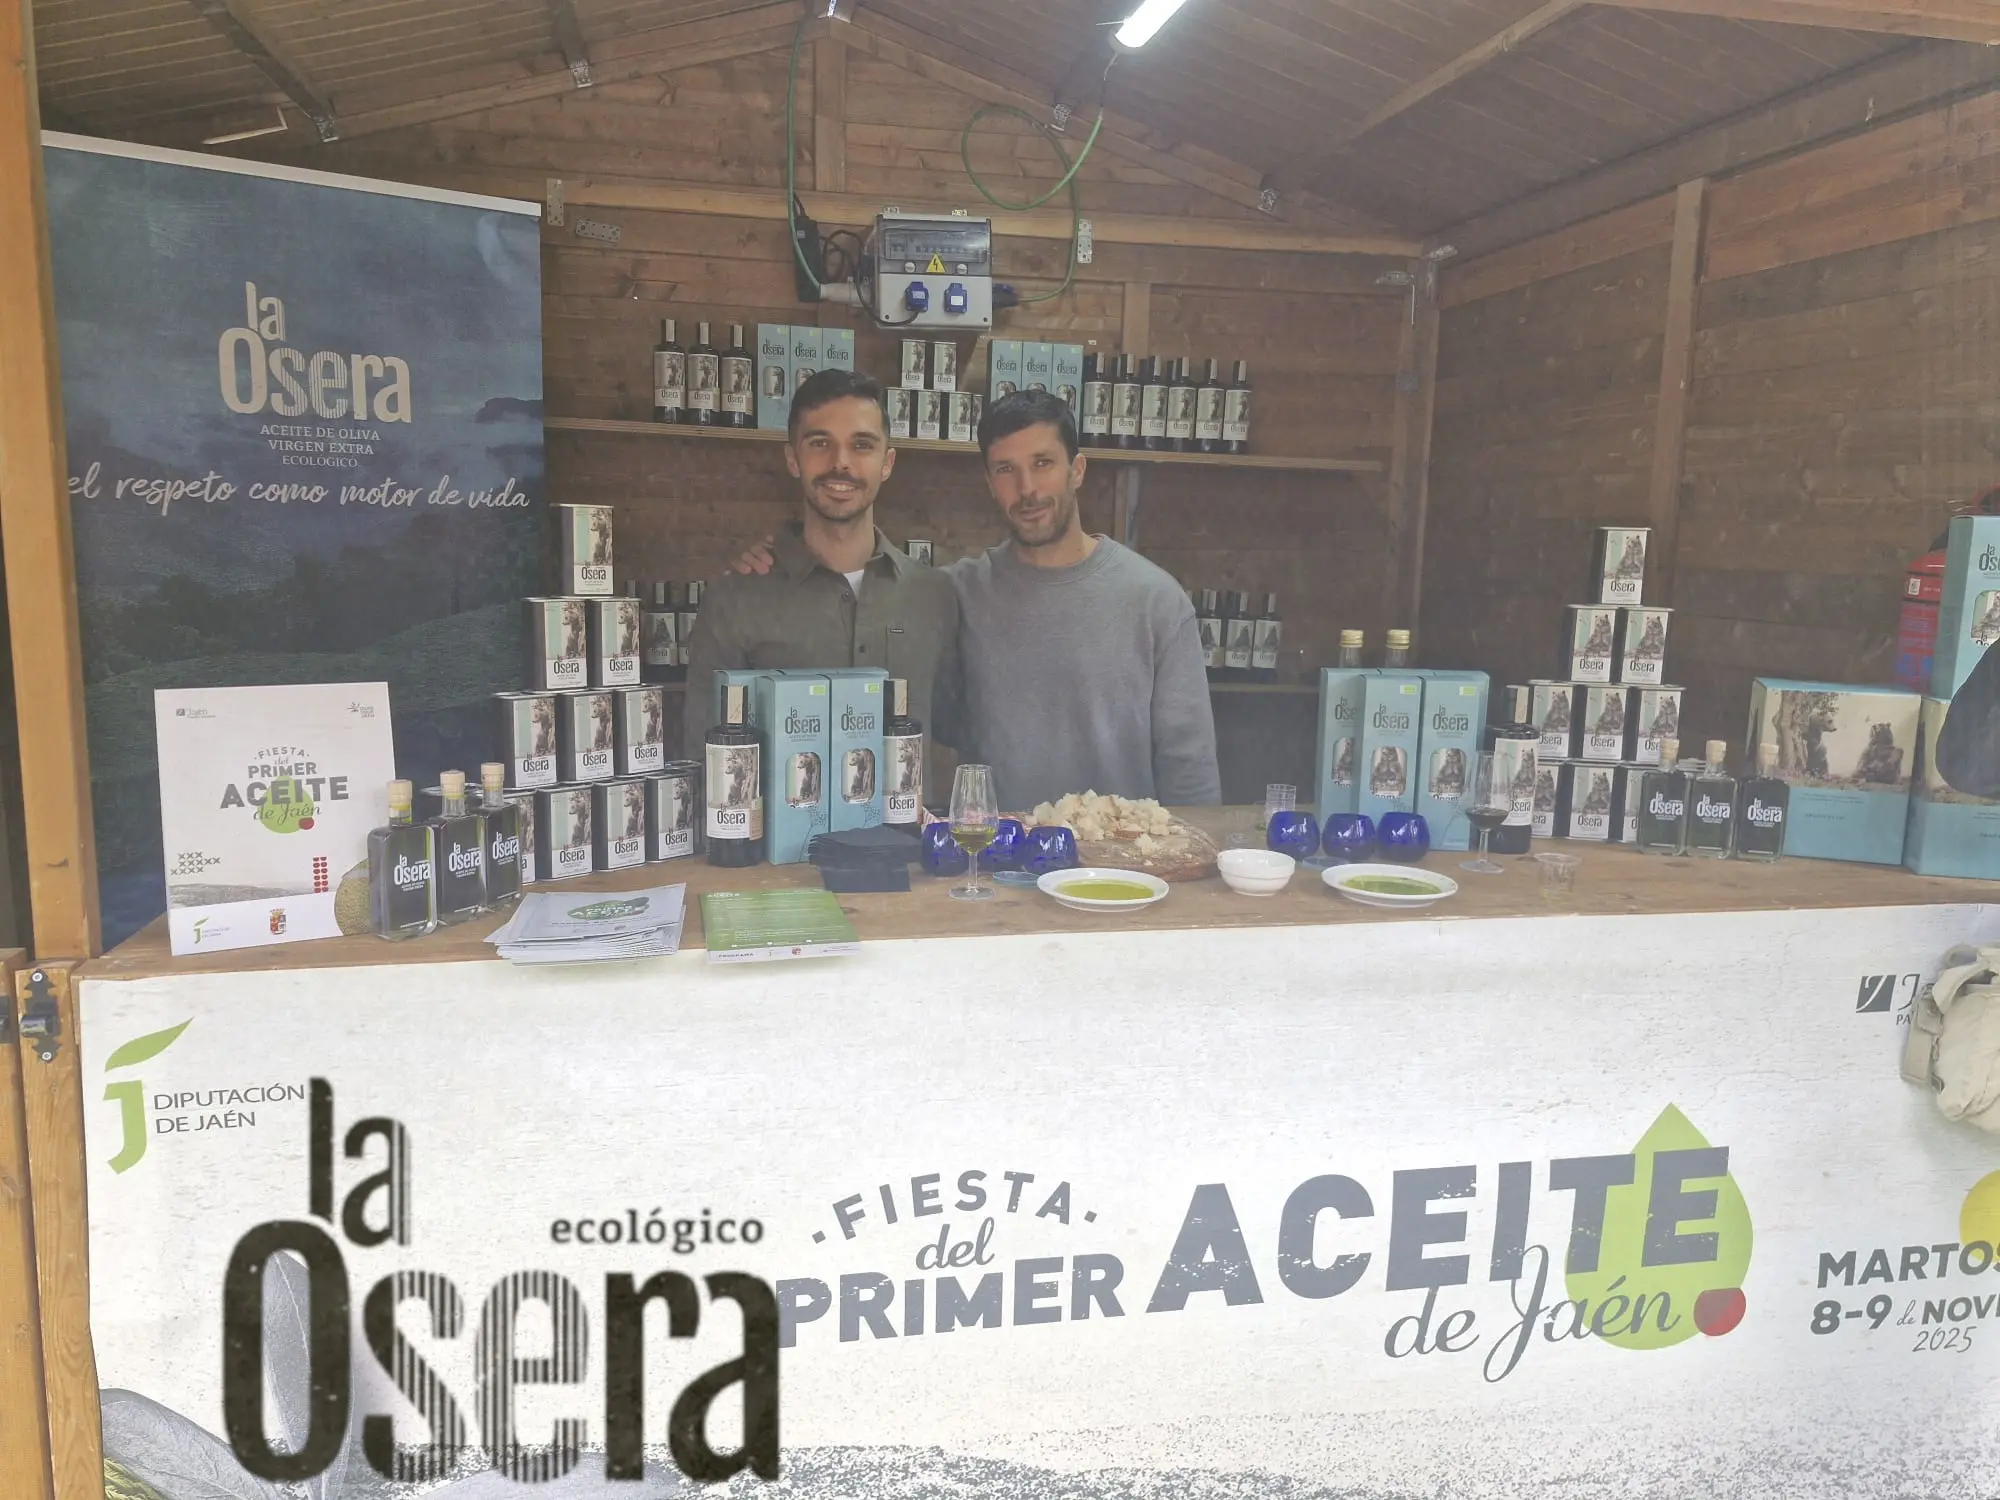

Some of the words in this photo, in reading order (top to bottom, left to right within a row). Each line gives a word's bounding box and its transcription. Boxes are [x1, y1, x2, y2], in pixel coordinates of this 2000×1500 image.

[246, 281, 285, 341] la
[218, 328, 412, 423] Osera
[260, 424, 312, 438] ACEITE
[316, 426, 336, 438] DE
[338, 427, 381, 441] OLIVA
[268, 440, 325, 453] VIRGEN
[328, 442, 375, 455] EXTRA
[68, 462, 101, 499] el
[115, 469, 239, 516] respeto
[248, 479, 329, 505] como
[340, 476, 422, 508] motor
[428, 474, 464, 506] de
[468, 477, 530, 509] vida
[581, 566, 607, 581] Osera
[553, 660, 580, 674] Osera
[609, 658, 633, 672] Osera
[784, 716, 821, 735] Osera
[841, 713, 875, 731] Osera
[1373, 711, 1410, 730] Osera
[1432, 713, 1469, 731] Osera
[258, 746, 305, 760] FIESTA
[582, 753, 608, 767] Osera
[634, 746, 658, 760] Osera
[247, 762, 317, 779] PRIMER
[523, 759, 549, 773] Osera
[220, 776, 349, 809] ACEITE
[889, 796, 915, 812] Osera
[1650, 798, 1684, 816] Osera
[1696, 801, 1731, 819] Osera
[253, 804, 274, 821] de
[276, 801, 322, 826] Jaén
[716, 810, 746, 825] Osera
[1747, 804, 1783, 823] Osera
[614, 840, 639, 855] Osera
[665, 831, 688, 846] Osera
[492, 838, 519, 860] Osera
[559, 849, 586, 864] Osera
[399, 854, 408, 867] la
[449, 850, 482, 872] Osera
[393, 863, 431, 886] Osera
[154, 1083, 305, 1110] DIPUTACIÓN
[156, 1116, 189, 1134] DE
[194, 1110, 256, 1131] JAÉN
[1146, 1146, 1729, 1313] ACEITE
[915, 1217, 995, 1272] del
[1817, 1240, 2000, 1289] MARTO
[778, 1253, 1125, 1348] PRIMER
[1385, 1286, 1479, 1358] de
[1483, 1244, 1680, 1383] Jaén
[1810, 1294, 1893, 1335] 8-9
[1896, 1299, 1917, 1326] de
[1921, 1294, 2000, 1325] NOV
[1912, 1326, 1977, 1353] 2025
